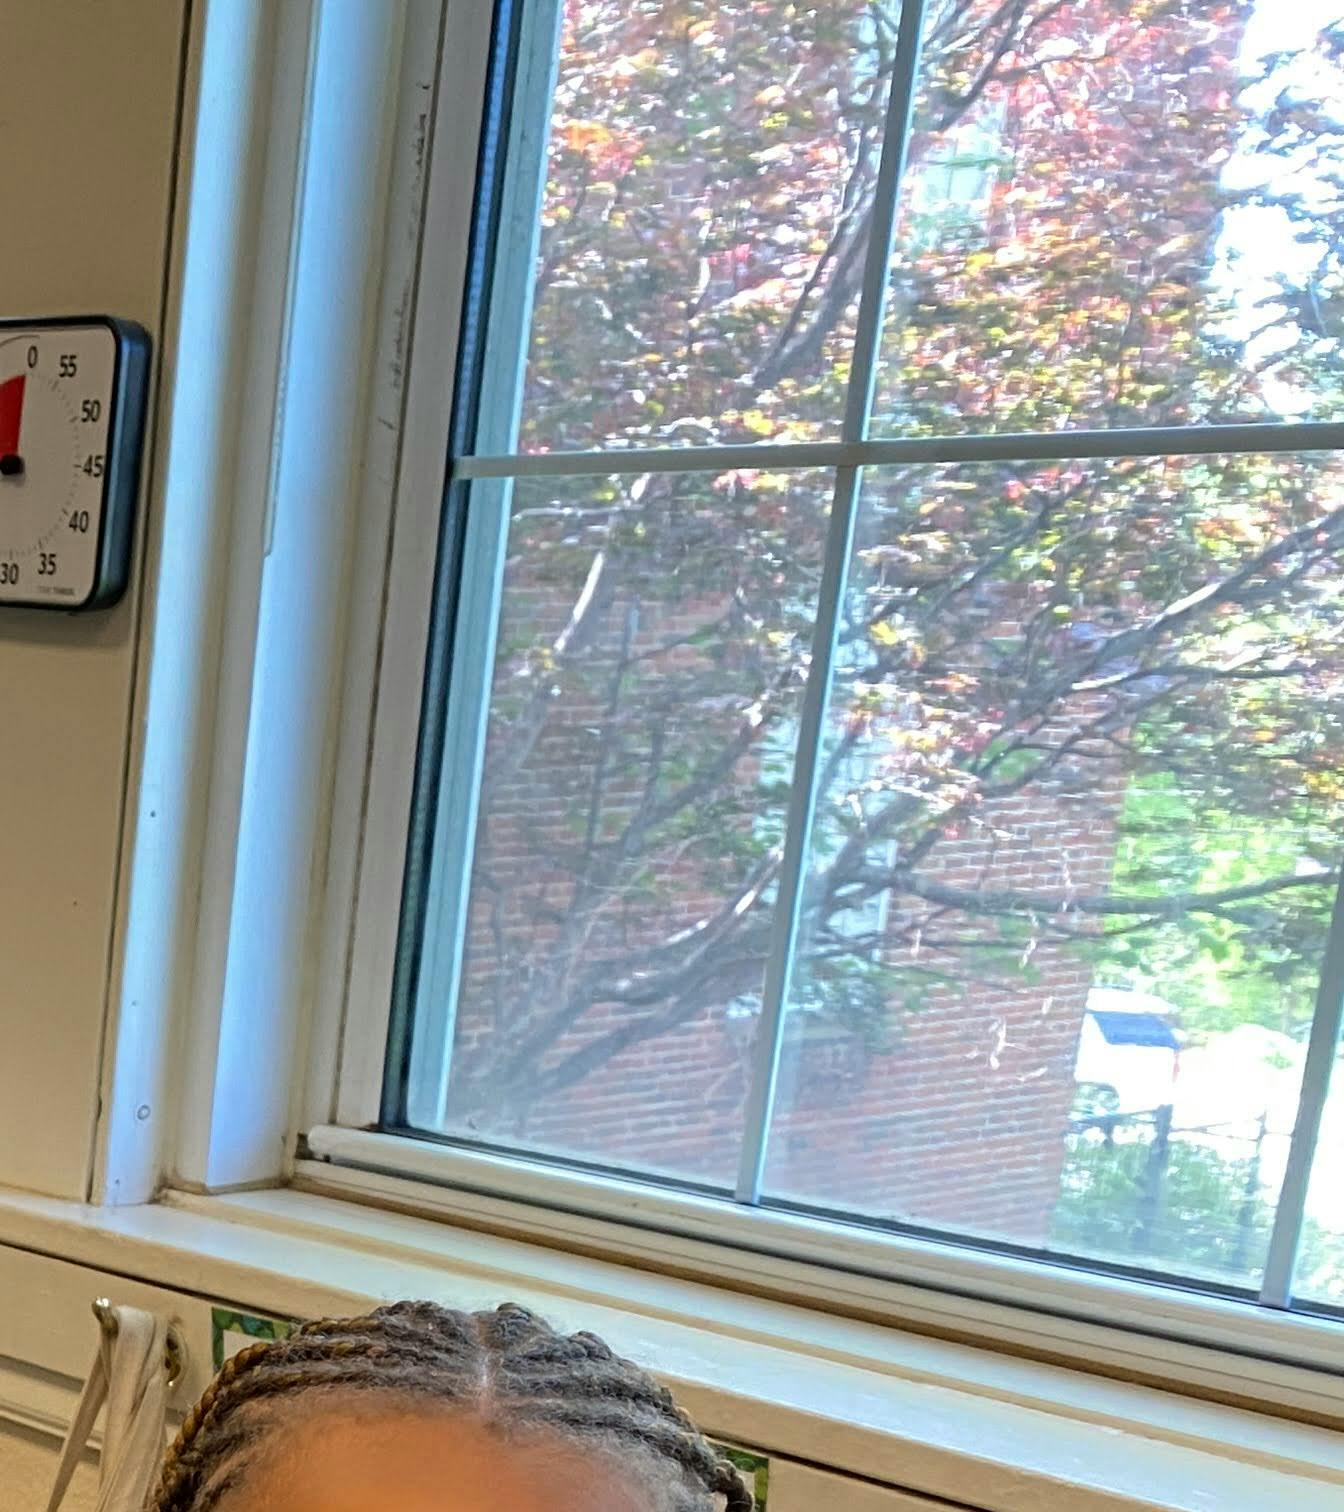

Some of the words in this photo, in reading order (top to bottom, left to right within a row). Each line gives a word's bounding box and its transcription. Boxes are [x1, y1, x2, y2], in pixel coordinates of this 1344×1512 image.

[26, 345, 38, 369] 0
[58, 354, 77, 379] 55
[80, 399, 101, 422] 50
[83, 454, 104, 478] 45
[69, 510, 89, 533] 40
[0, 562, 20, 585] 30
[37, 552, 57, 576] 35
